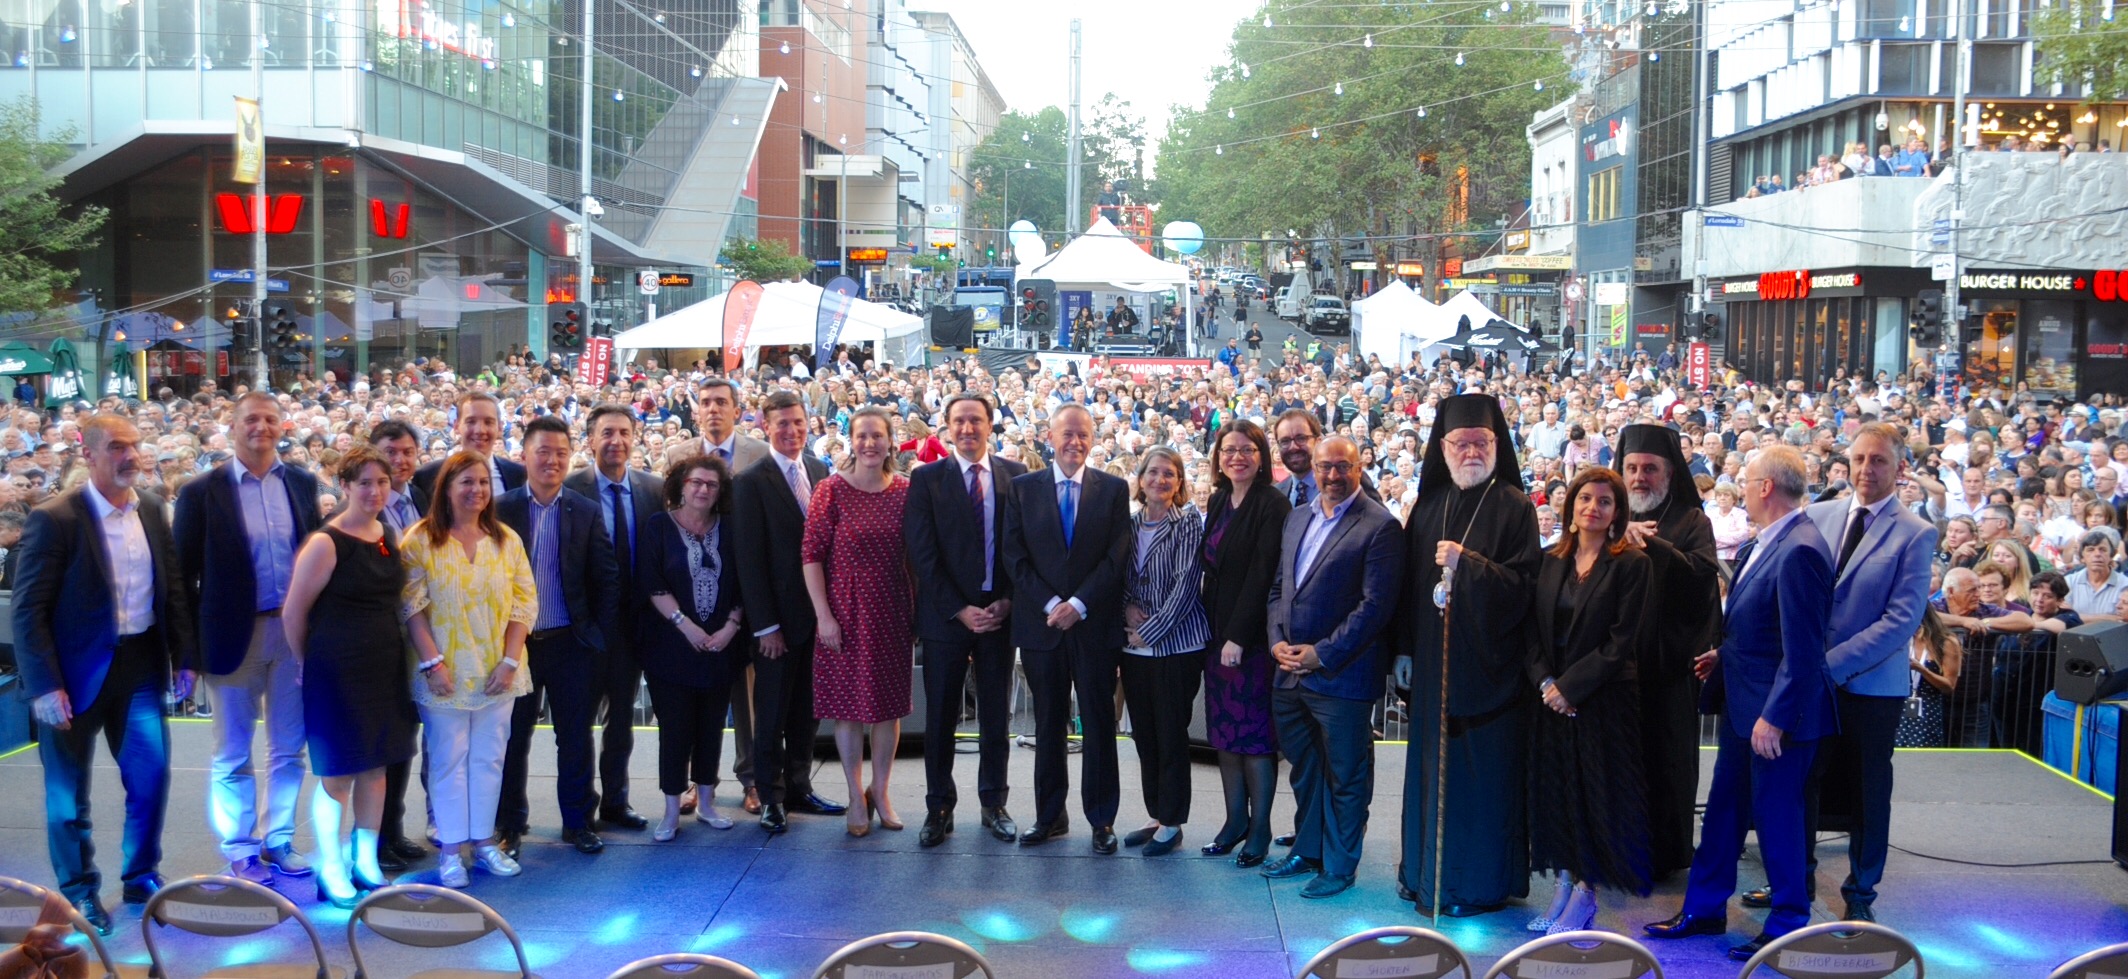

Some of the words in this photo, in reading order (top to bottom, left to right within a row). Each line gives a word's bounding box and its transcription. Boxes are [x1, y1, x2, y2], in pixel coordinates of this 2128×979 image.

[644, 278, 656, 287] 40
[1741, 280, 1758, 293] HOUSE
[1812, 275, 1833, 289] BURGER
[1833, 273, 1855, 287] HOUSE
[1960, 275, 2017, 289] BURGER
[2020, 276, 2072, 290] HOUSE
[597, 344, 608, 361] NO
[1694, 347, 1705, 365] NO
[1122, 364, 1174, 374] TANDING
[1788, 955, 1831, 968] BISHOP
[1368, 966, 1411, 975] SHORTEN
